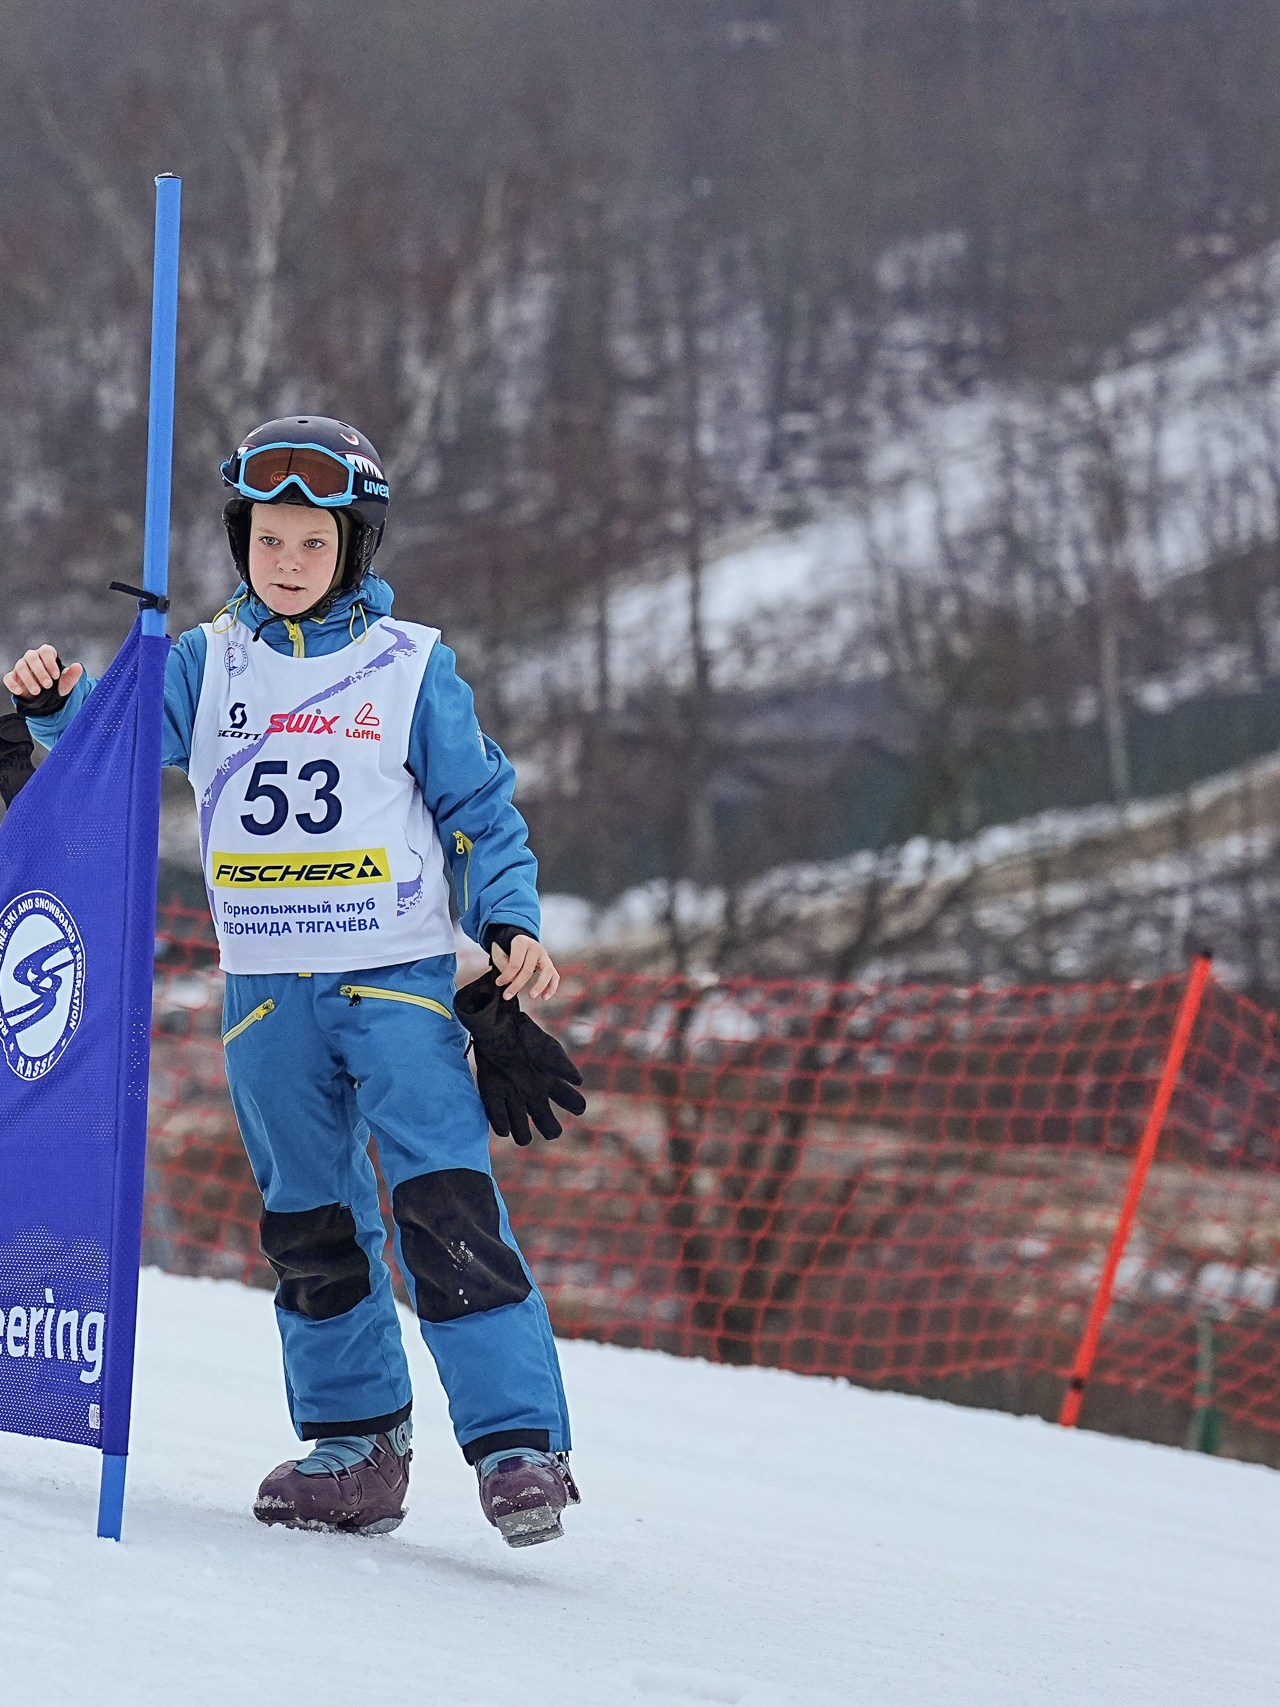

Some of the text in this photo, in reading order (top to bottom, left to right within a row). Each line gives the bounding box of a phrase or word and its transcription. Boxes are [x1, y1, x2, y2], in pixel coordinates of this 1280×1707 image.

[240, 759, 342, 836] 53
[216, 863, 356, 882] FISCHER
[223, 898, 376, 918] Горнолыжный клуб
[223, 917, 380, 937] ЛЕОНИДА ТЯГАЧЁВА
[4, 909, 19, 929] SKI
[17, 898, 34, 915] AND
[34, 897, 76, 944] SNOWBOARD
[69, 942, 84, 1030] FEDERATION
[16, 1050, 56, 1079] RASSF
